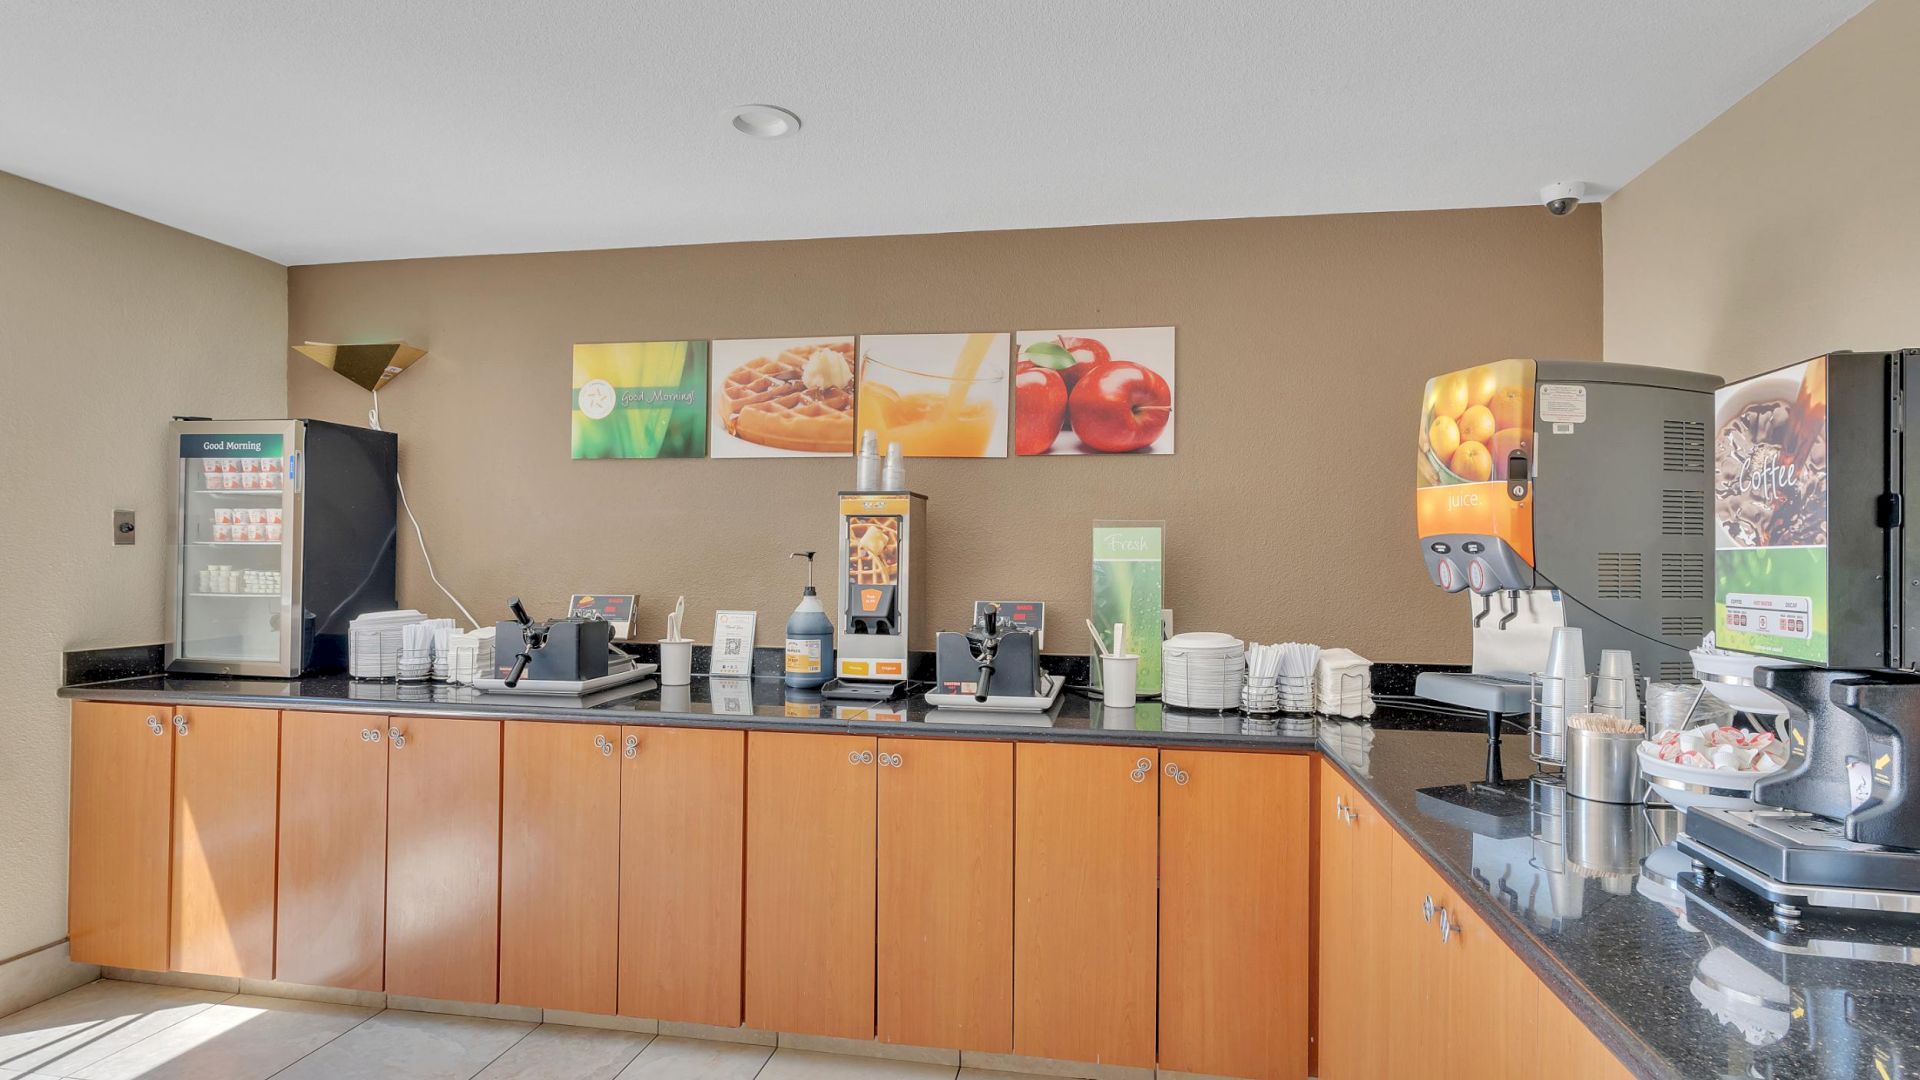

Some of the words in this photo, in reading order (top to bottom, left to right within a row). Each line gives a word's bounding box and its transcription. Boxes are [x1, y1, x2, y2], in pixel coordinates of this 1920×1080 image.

[622, 391, 644, 408] Good
[648, 390, 695, 405] Morning!
[203, 441, 224, 450] Good
[226, 441, 262, 452] Morning
[1740, 453, 1797, 500] Coffee
[1103, 533, 1149, 551] Fresh
